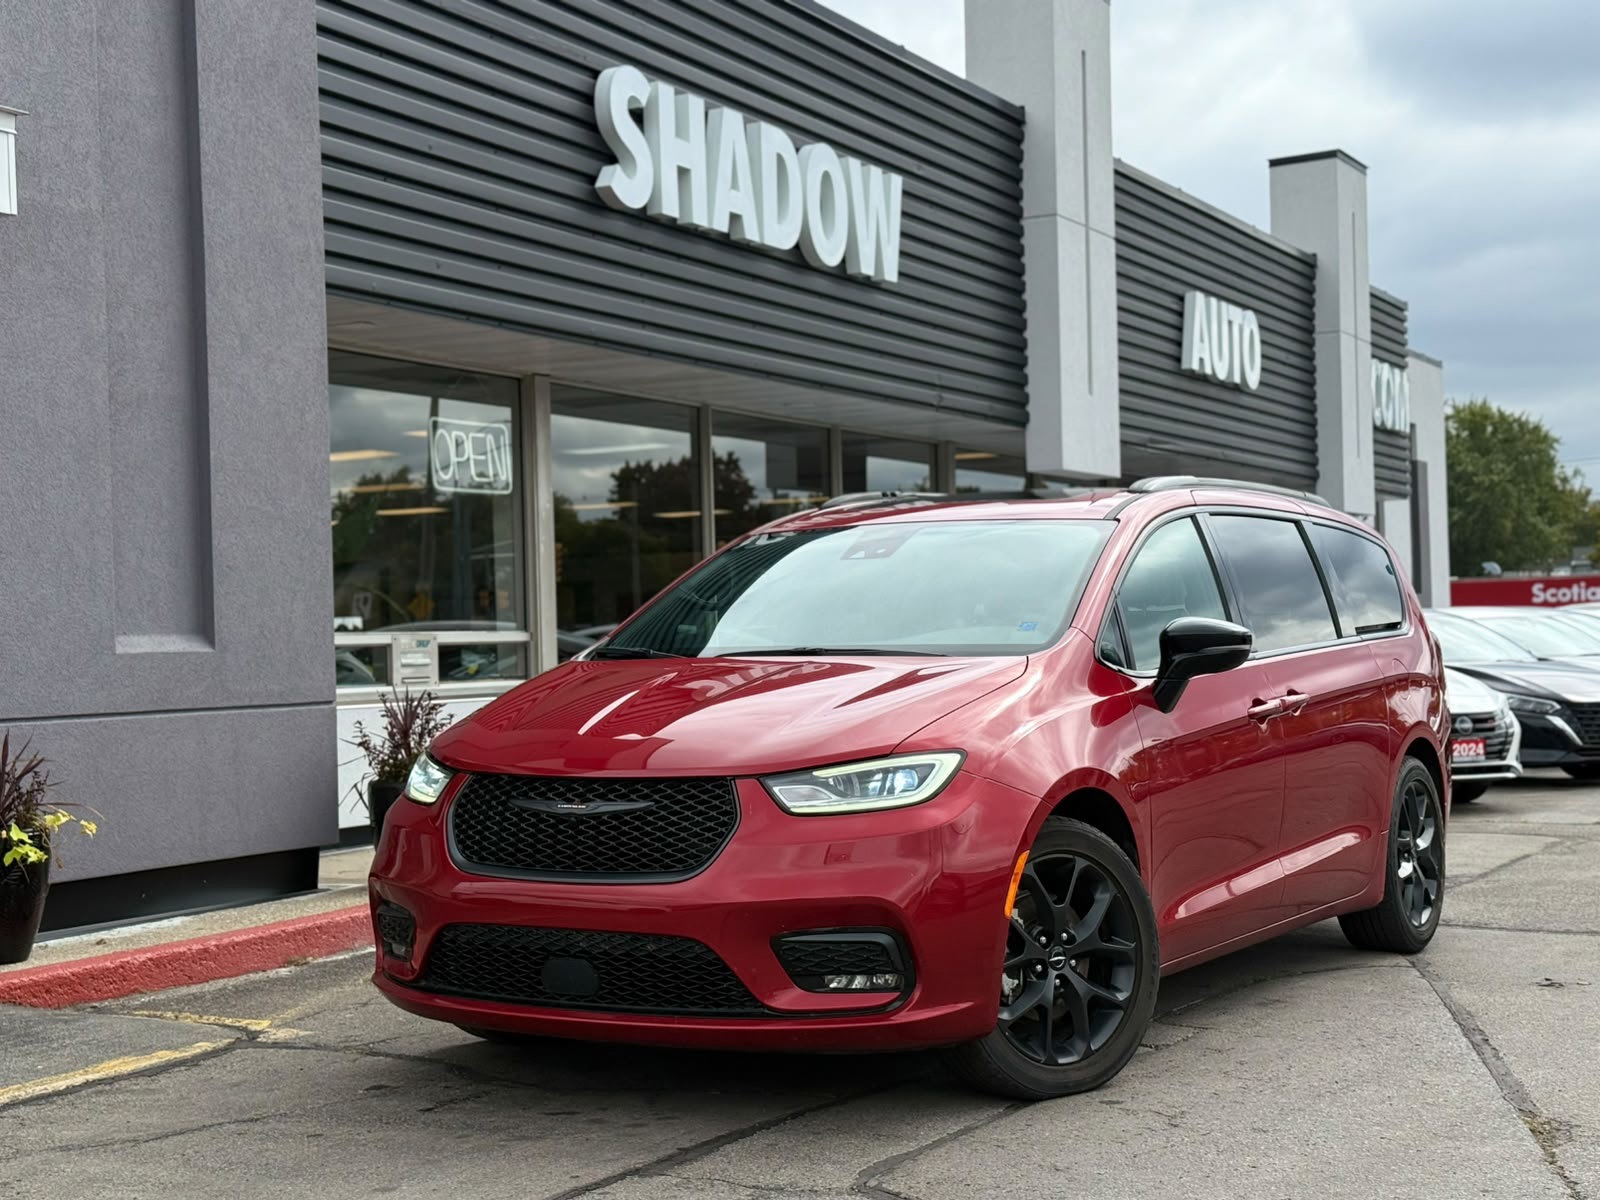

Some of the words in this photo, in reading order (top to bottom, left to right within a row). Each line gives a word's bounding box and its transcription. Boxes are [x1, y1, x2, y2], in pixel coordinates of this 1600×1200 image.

[594, 65, 903, 283] SHADOW
[1181, 290, 1262, 390] AUTO
[434, 429, 507, 482] OPEN
[1531, 581, 1600, 603] Scotia
[1452, 742, 1485, 757] 2024
